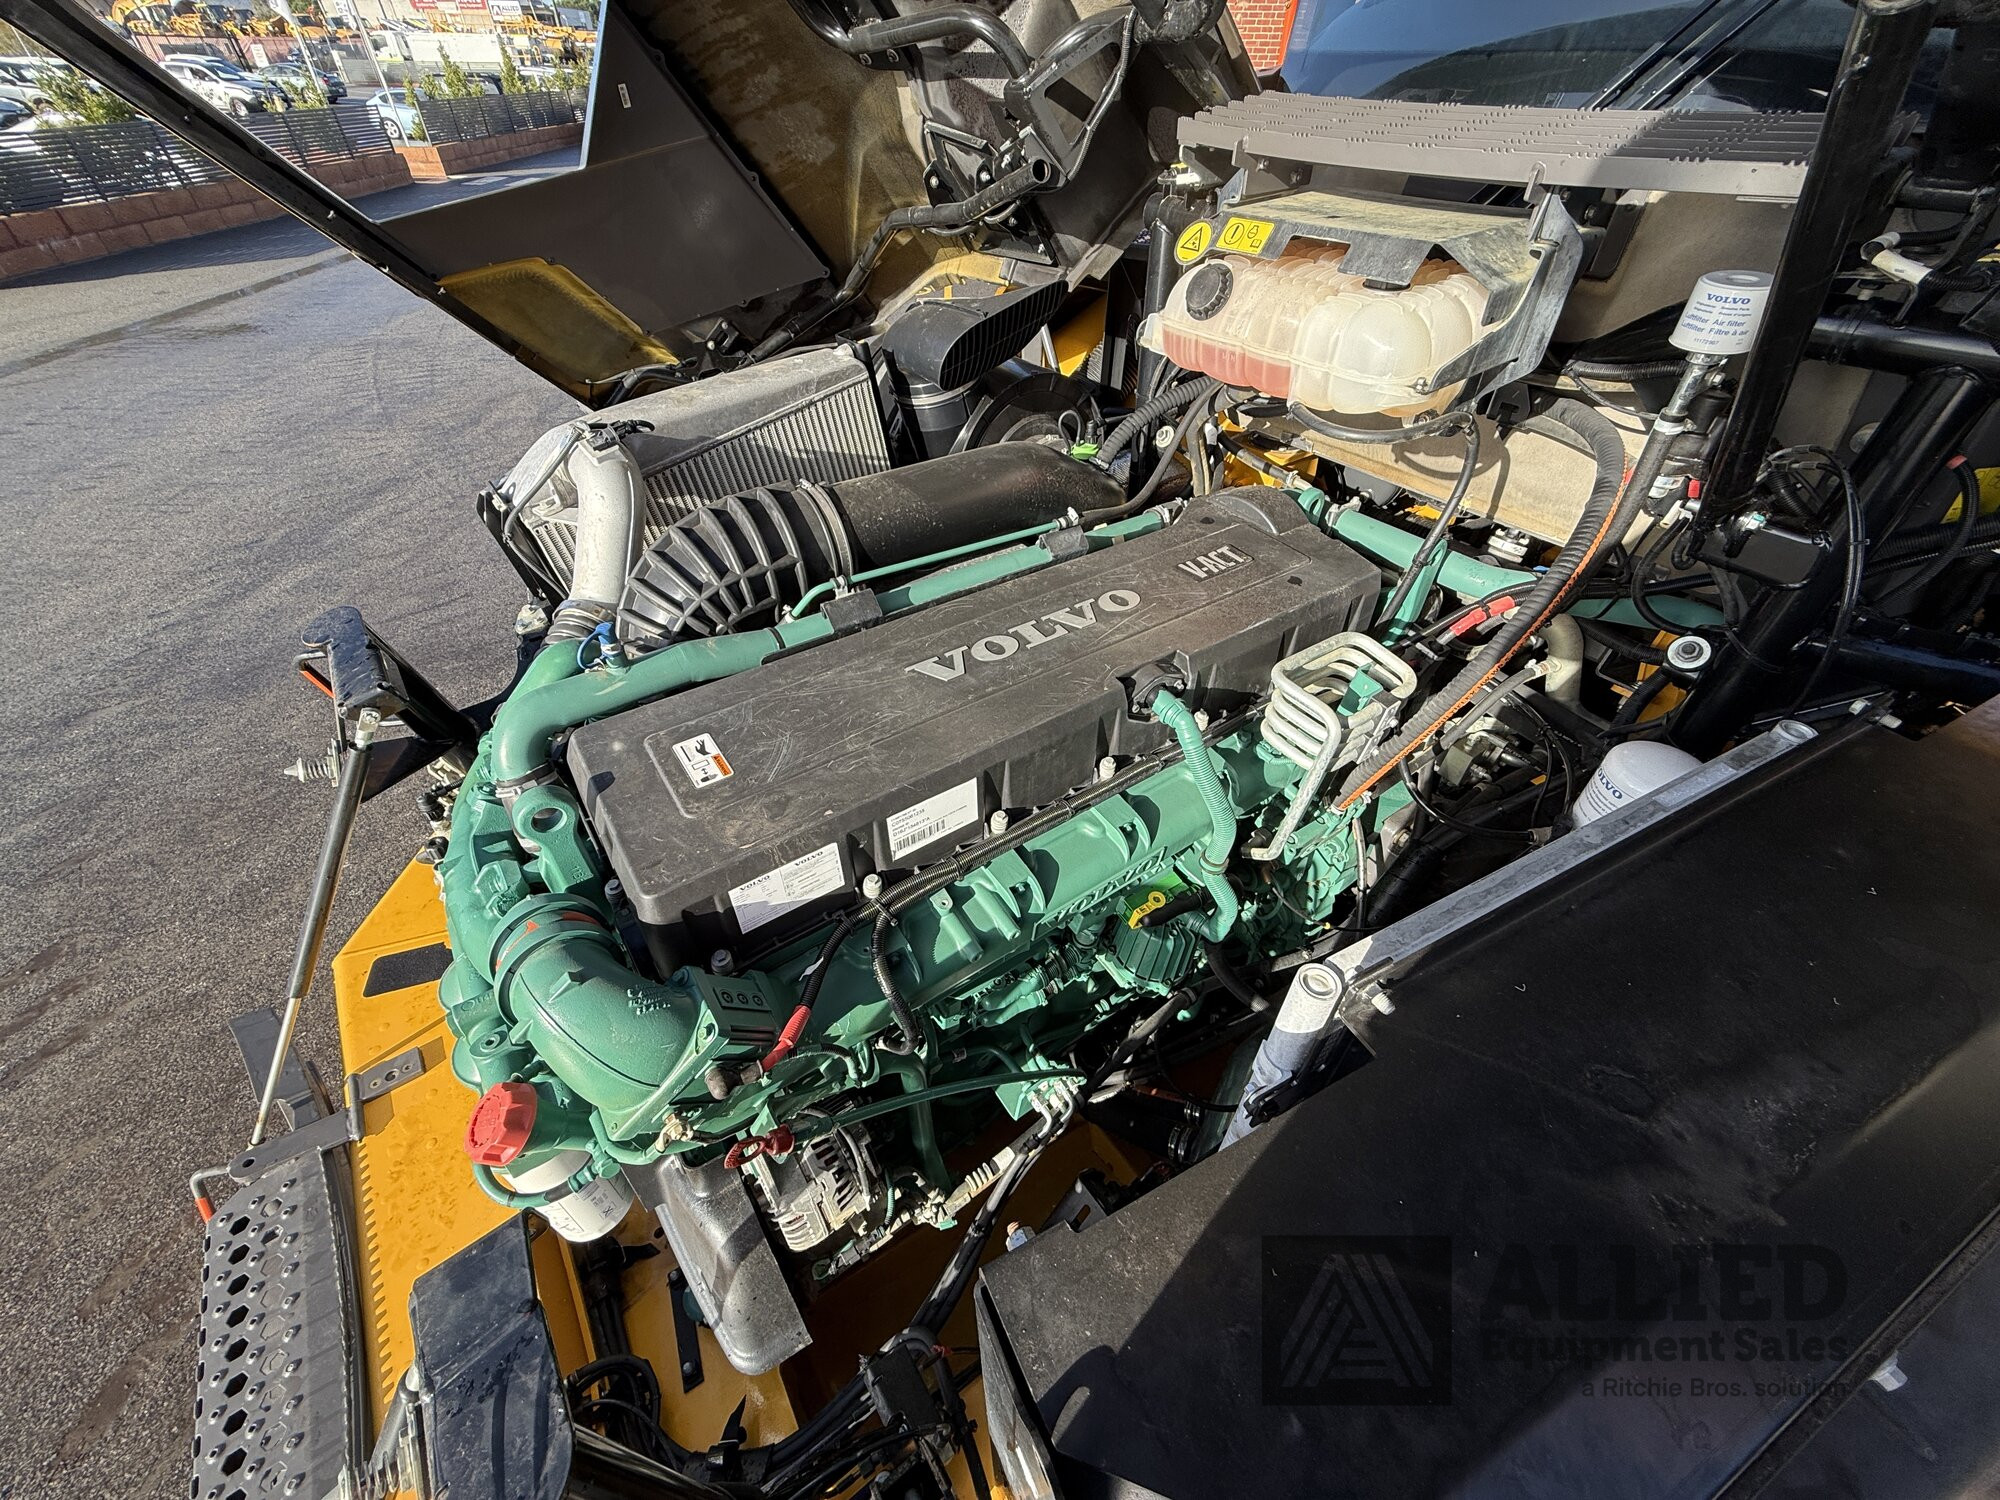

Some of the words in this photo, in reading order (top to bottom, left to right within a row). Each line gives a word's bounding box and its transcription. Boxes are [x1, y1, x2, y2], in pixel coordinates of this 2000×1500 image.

[1707, 293, 1751, 305] VOLVO
[1712, 319, 1726, 327] Air
[1709, 327, 1730, 336] Filtre
[1177, 545, 1245, 579] V-ACT
[904, 589, 1142, 682] VOLVO
[1597, 767, 1623, 800] OLVO
[794, 851, 824, 867] VOLVO
[739, 875, 770, 891] VOLVO
